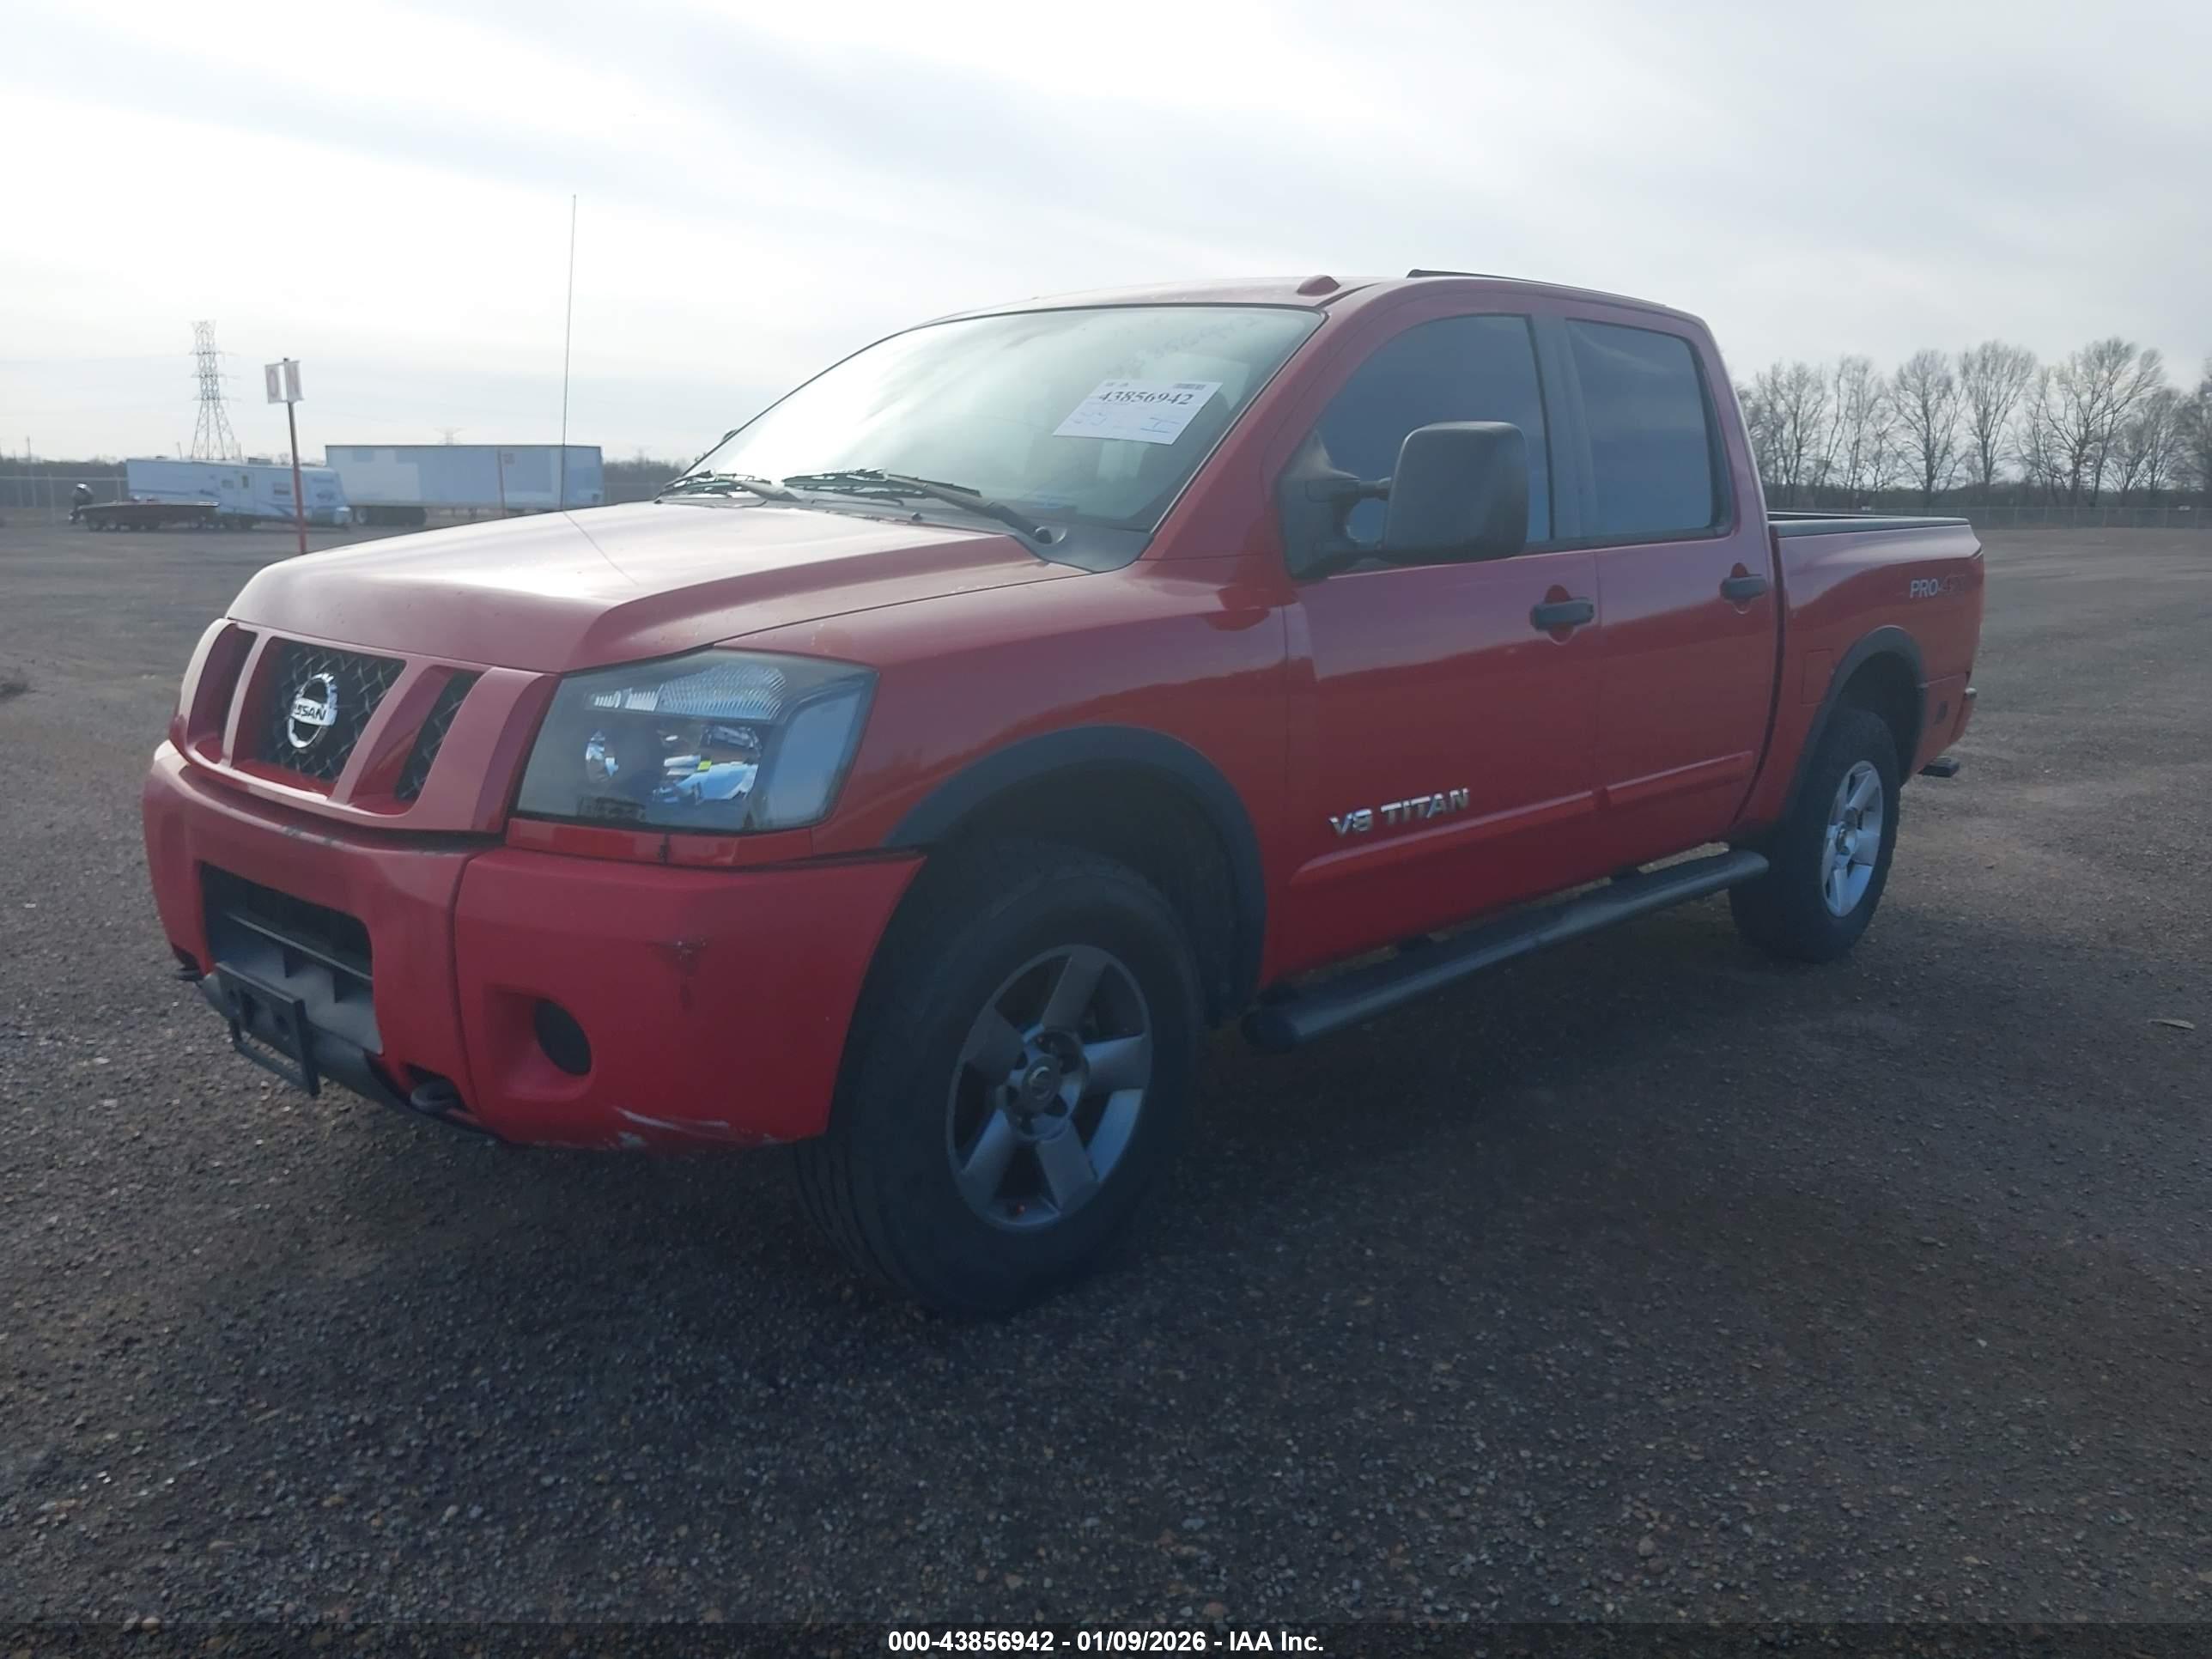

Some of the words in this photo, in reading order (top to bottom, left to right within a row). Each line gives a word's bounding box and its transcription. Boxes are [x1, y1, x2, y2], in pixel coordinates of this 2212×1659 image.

[1098, 391, 1194, 405] 43856942
[1329, 808, 1373, 836] V8
[1380, 787, 1470, 825] TITAN
